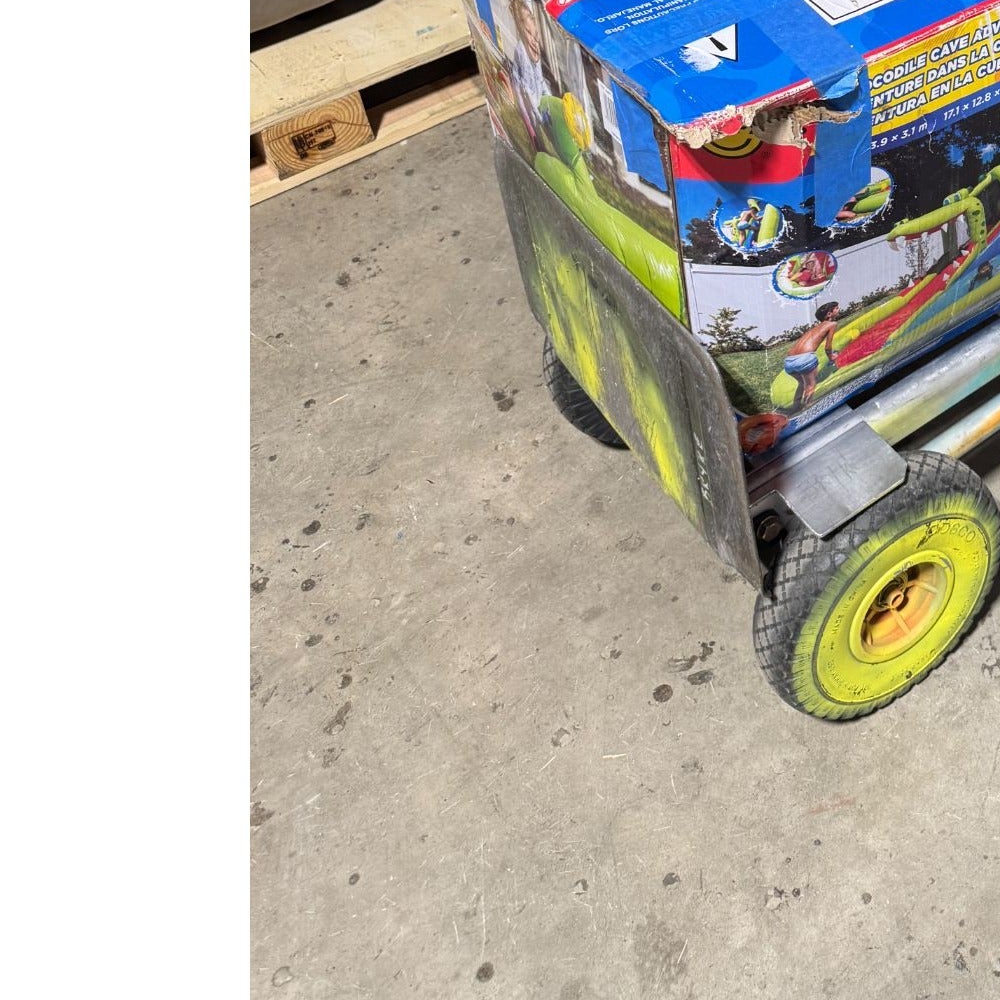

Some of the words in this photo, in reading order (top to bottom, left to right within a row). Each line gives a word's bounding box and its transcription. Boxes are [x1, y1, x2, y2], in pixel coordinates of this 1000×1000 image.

[869, 55, 927, 93] CODILE
[930, 33, 970, 64] CAVE
[871, 74, 924, 110] NTURE
[926, 55, 968, 82] DANS
[969, 46, 990, 66] LA
[871, 93, 928, 126] NTURA
[929, 83, 952, 103] EN
[953, 73, 974, 93] LA
[900, 125, 916, 139] 3.1
[943, 106, 960, 121] 17.1
[971, 92, 991, 107] 12.8
